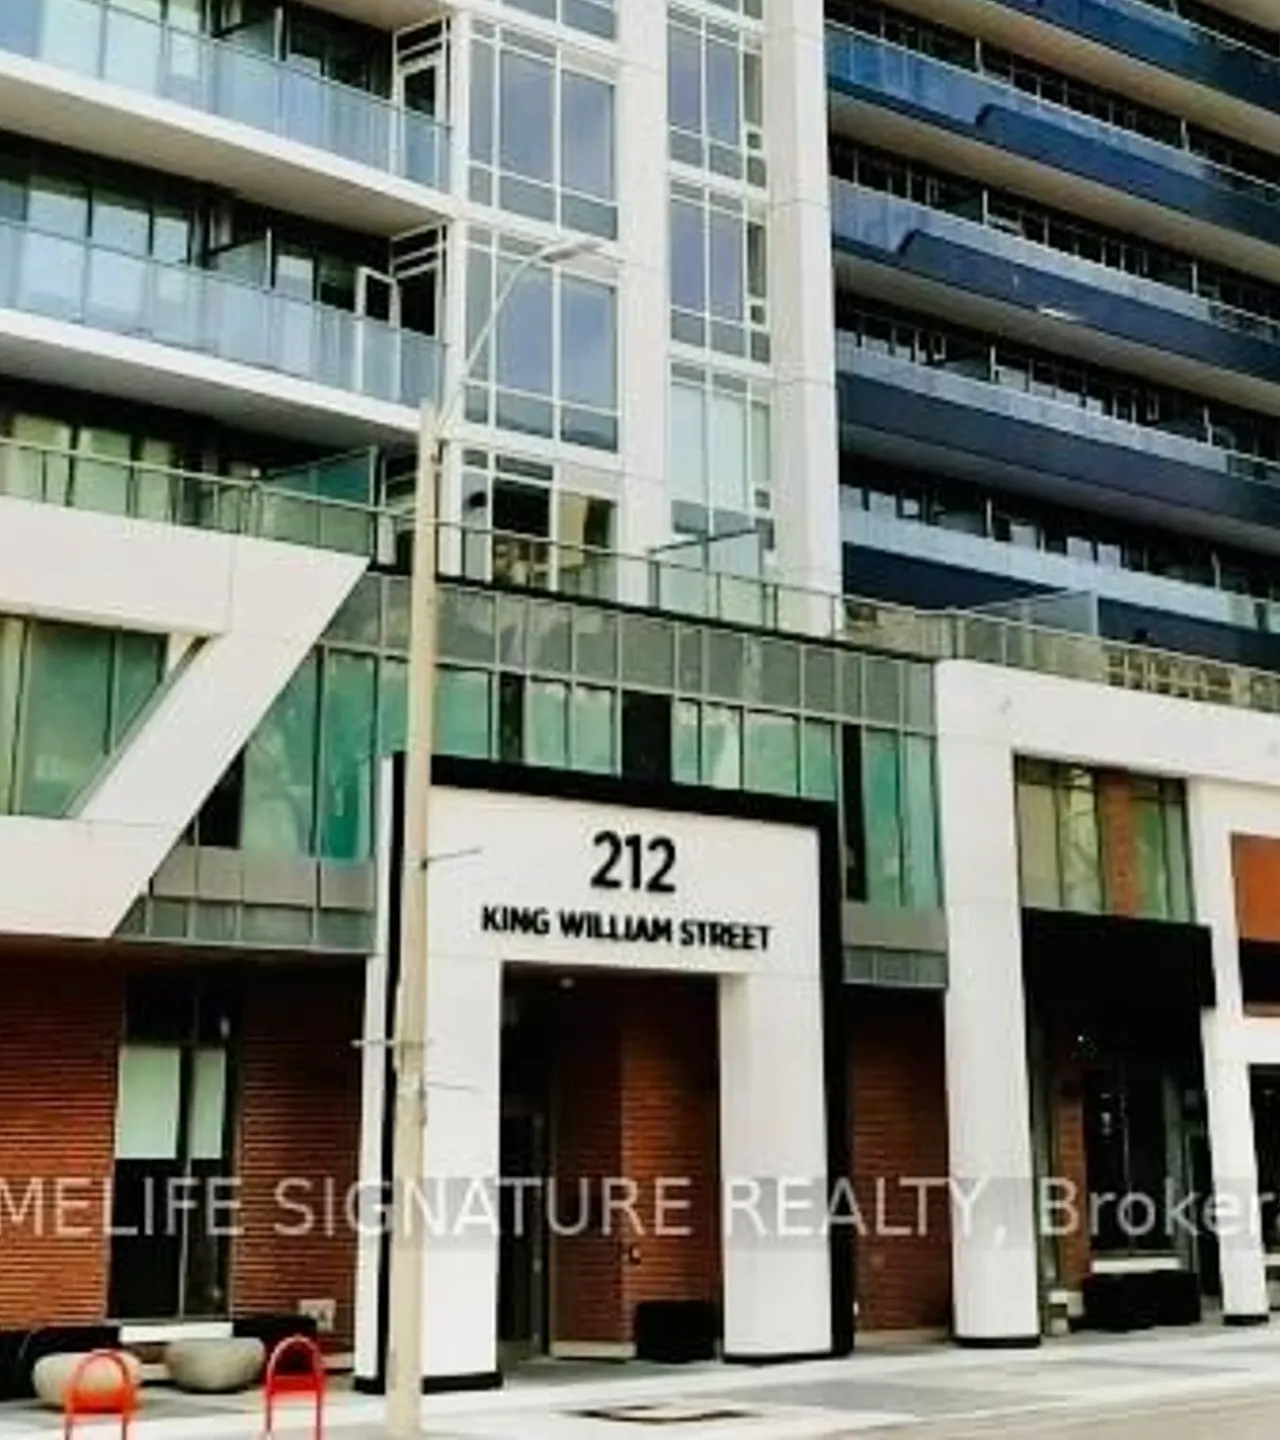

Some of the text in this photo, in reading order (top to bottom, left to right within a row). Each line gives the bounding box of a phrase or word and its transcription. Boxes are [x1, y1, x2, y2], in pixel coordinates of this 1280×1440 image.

[591, 830, 677, 894] 212
[481, 904, 773, 952] KING WILLIAM STREET
